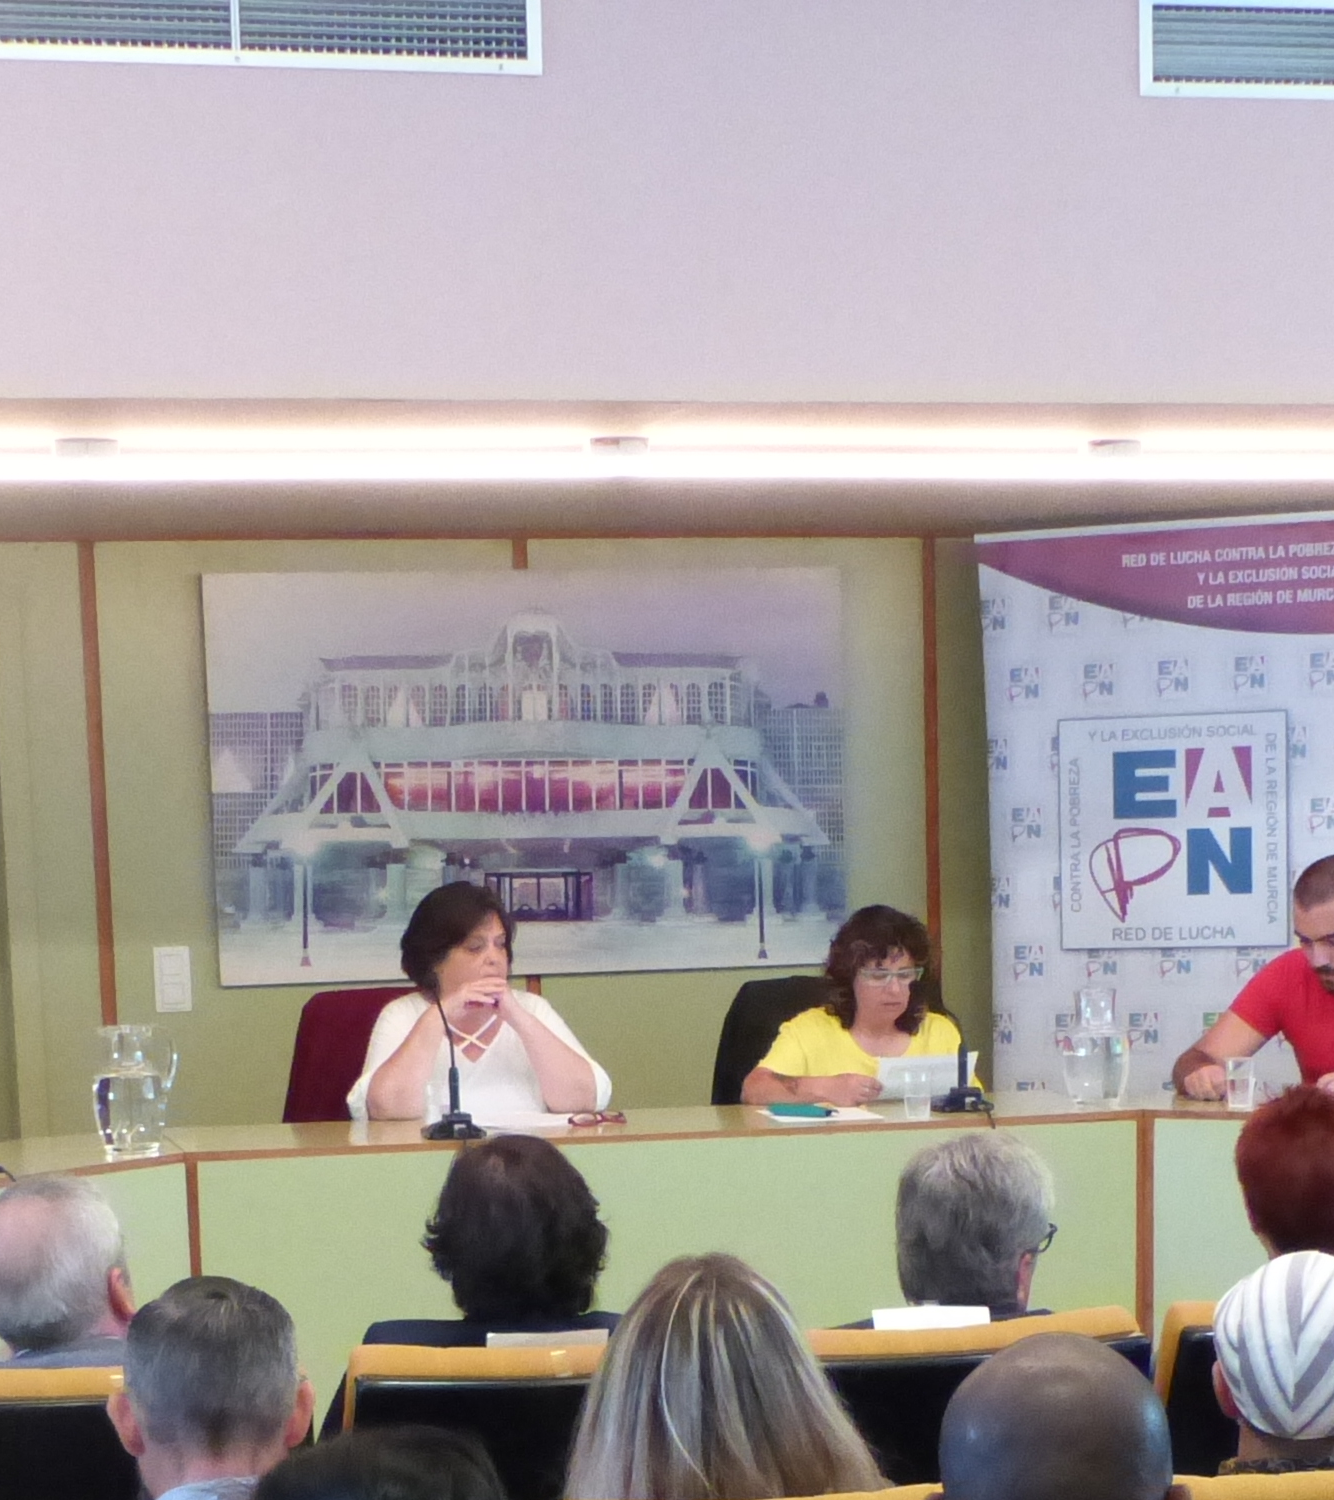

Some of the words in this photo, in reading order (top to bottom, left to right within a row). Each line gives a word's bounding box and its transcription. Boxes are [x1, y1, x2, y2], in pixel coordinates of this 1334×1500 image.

[1122, 554, 1146, 567] RED
[1150, 553, 1166, 565] DE
[1170, 550, 1212, 564] LUCHA
[1214, 546, 1265, 561] CONTRA
[1269, 545, 1285, 558] LA
[1197, 572, 1205, 585] Y
[1208, 571, 1225, 584] LA
[1228, 565, 1298, 583] EXCLUSIÓN
[1187, 595, 1204, 608] DE
[1207, 594, 1223, 607] LA
[1227, 589, 1272, 606] REGIÓN
[1276, 589, 1293, 603] DE
[1088, 731, 1097, 741] Y
[1100, 729, 1116, 742] LA
[1121, 724, 1202, 741] EXCLUSIÓN
[1206, 724, 1257, 737] SOCIAL
[1265, 733, 1277, 753] DE
[1265, 757, 1277, 776] LA
[1069, 757, 1081, 827] POBREZA
[1112, 745, 1253, 819] EA
[1266, 780, 1279, 838] REGIÓN
[1069, 829, 1081, 849] LA
[1267, 841, 1278, 862] DE
[1069, 852, 1082, 913] CONTRA
[1267, 865, 1278, 925] MURCIA
[1112, 927, 1147, 941] RED
[1151, 927, 1173, 940] DE
[1179, 926, 1236, 940] LUCHA
